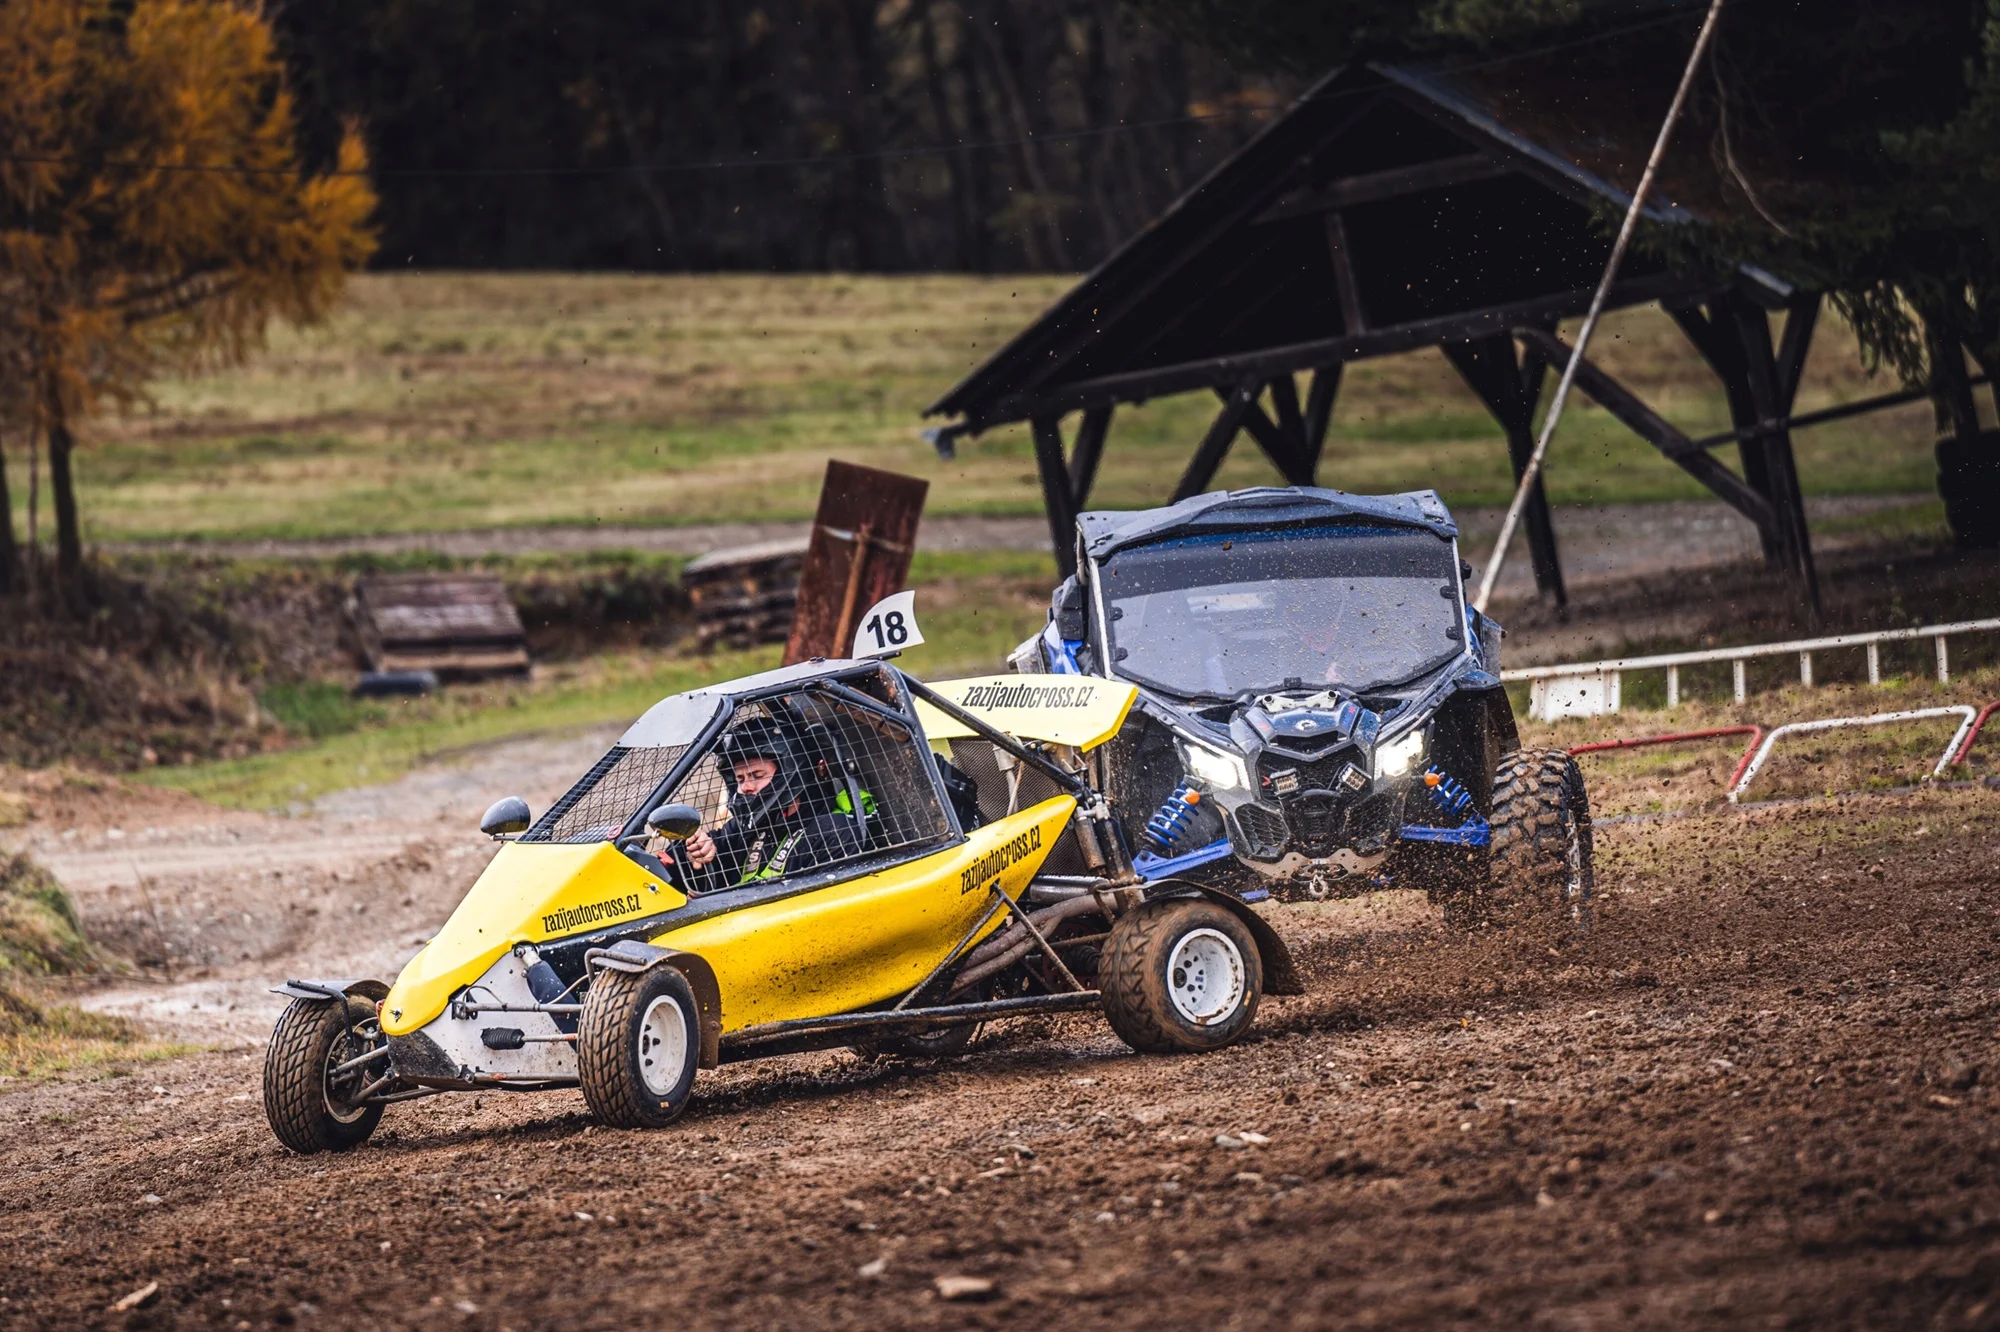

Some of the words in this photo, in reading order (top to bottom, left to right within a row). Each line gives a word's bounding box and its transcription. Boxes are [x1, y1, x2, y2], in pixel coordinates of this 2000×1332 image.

[867, 611, 908, 649] 18
[961, 681, 1095, 712] zazijautocross.cz
[961, 825, 1042, 896] zazijautocross.cz
[542, 894, 642, 933] zazijautocross.cz
